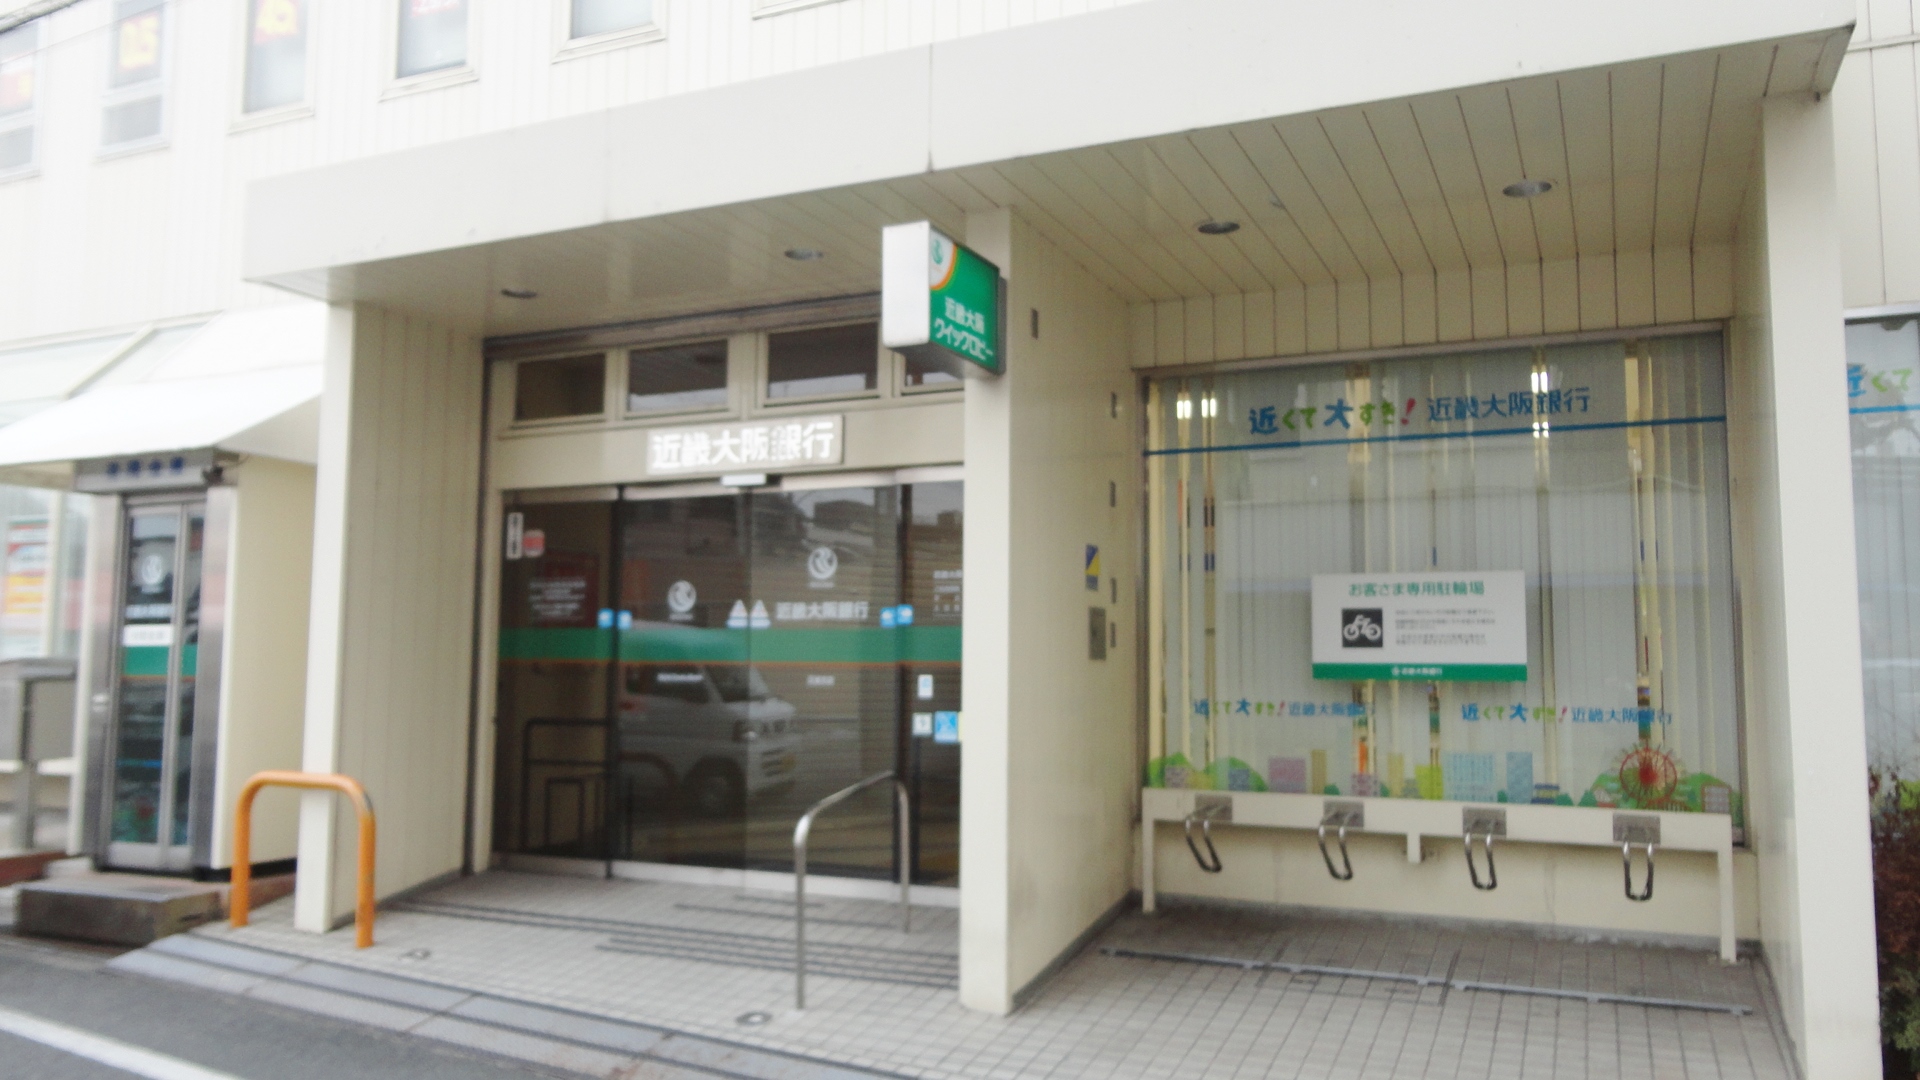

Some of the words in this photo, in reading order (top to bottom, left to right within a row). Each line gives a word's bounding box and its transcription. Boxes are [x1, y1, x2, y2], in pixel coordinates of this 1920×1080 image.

[945, 295, 985, 335] 近畿大阪
[934, 317, 994, 361] クイックロビー
[1427, 387, 1592, 422] 近畿大阪銀行
[652, 421, 835, 469] 近畿大阪銀行
[1348, 580, 1486, 597] お客さま専用駐輪場
